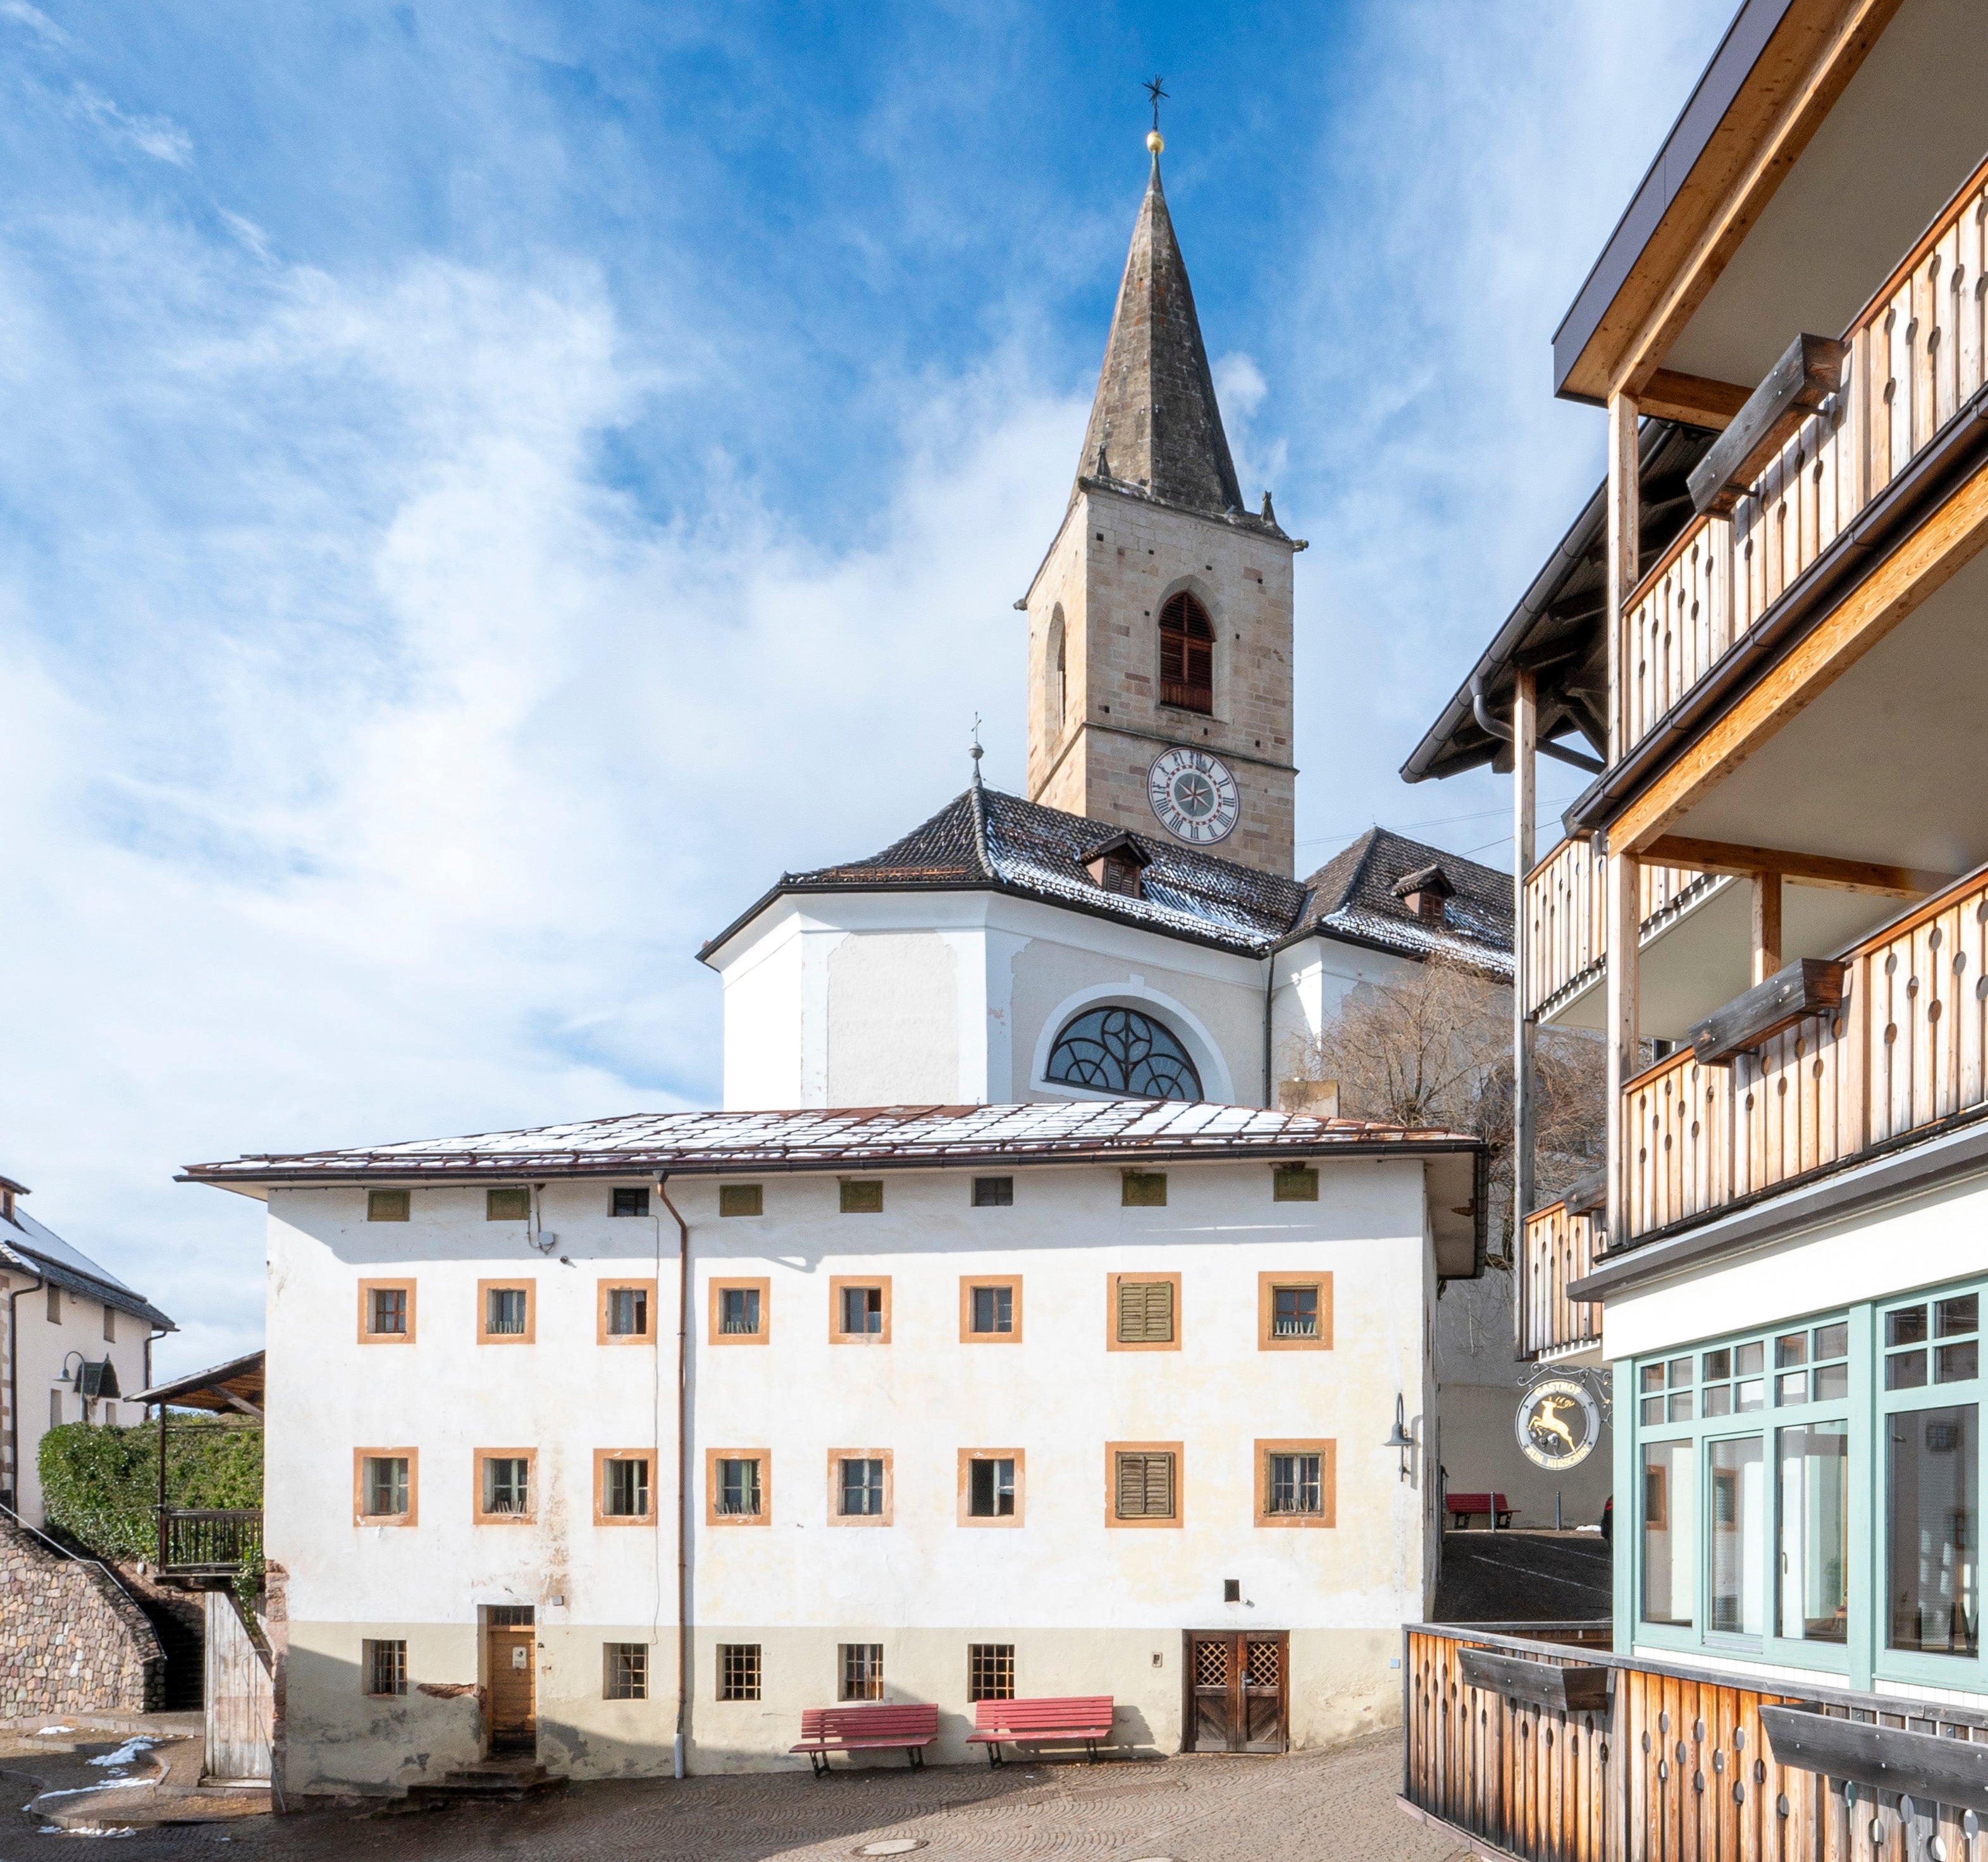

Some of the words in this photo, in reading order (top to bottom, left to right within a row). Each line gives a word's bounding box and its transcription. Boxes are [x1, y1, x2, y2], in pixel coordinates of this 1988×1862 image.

[1223, 797, 1235, 807] III
[1534, 1381, 1583, 1397] GASTHOF
[1525, 1445, 1543, 1464] ZUM
[1547, 1445, 1590, 1469] HIRSCHEN
